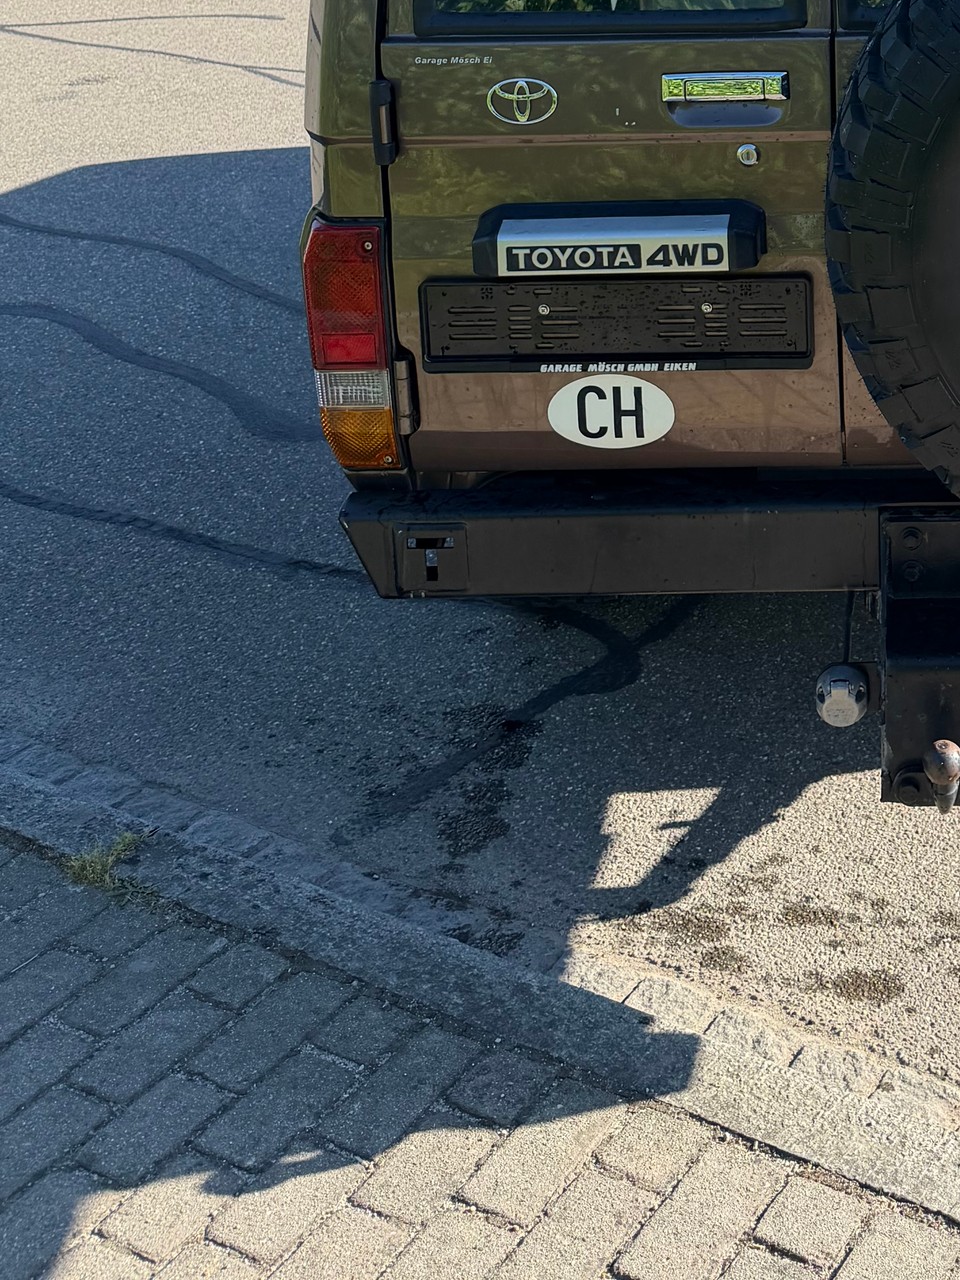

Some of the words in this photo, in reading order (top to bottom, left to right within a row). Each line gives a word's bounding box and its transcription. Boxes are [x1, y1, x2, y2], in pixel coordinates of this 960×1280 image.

[414, 56, 448, 66] Garage
[450, 56, 481, 64] Mösch
[512, 246, 635, 269] TOYOTA
[646, 242, 725, 267] 4WD
[540, 364, 583, 373] GARAGE
[587, 362, 625, 372] MÖSCH
[627, 363, 659, 372] GMBH
[663, 362, 697, 371] EIKEN
[577, 385, 645, 439] CH
